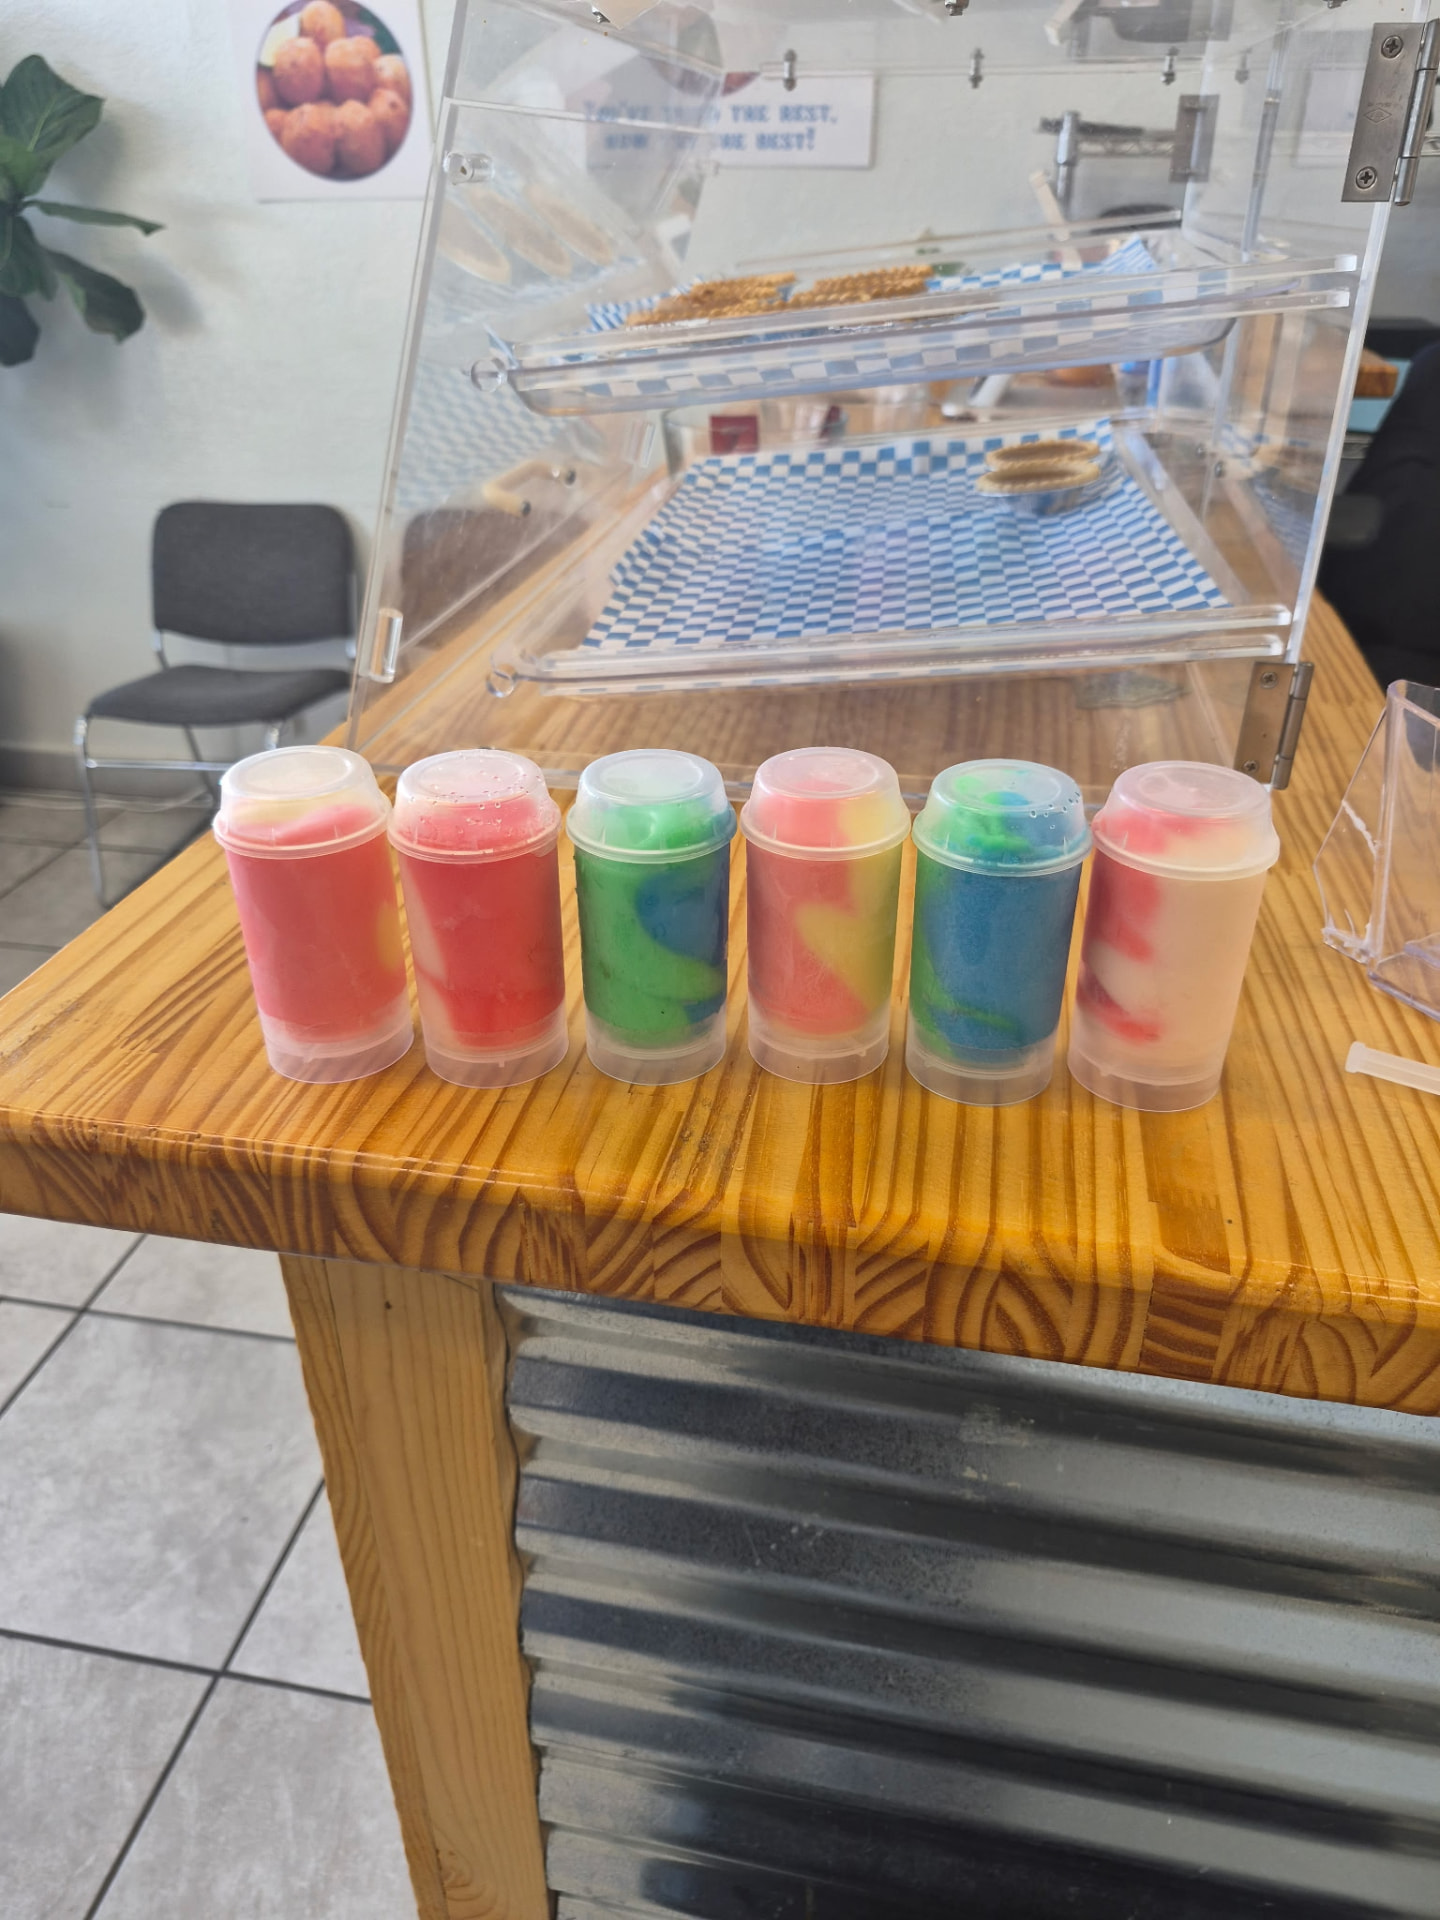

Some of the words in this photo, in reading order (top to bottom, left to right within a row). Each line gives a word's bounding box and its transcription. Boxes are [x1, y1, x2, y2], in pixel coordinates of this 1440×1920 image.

[730, 104, 769, 122] THE
[779, 104, 837, 124] REST,
[756, 127, 815, 150] BEST!
